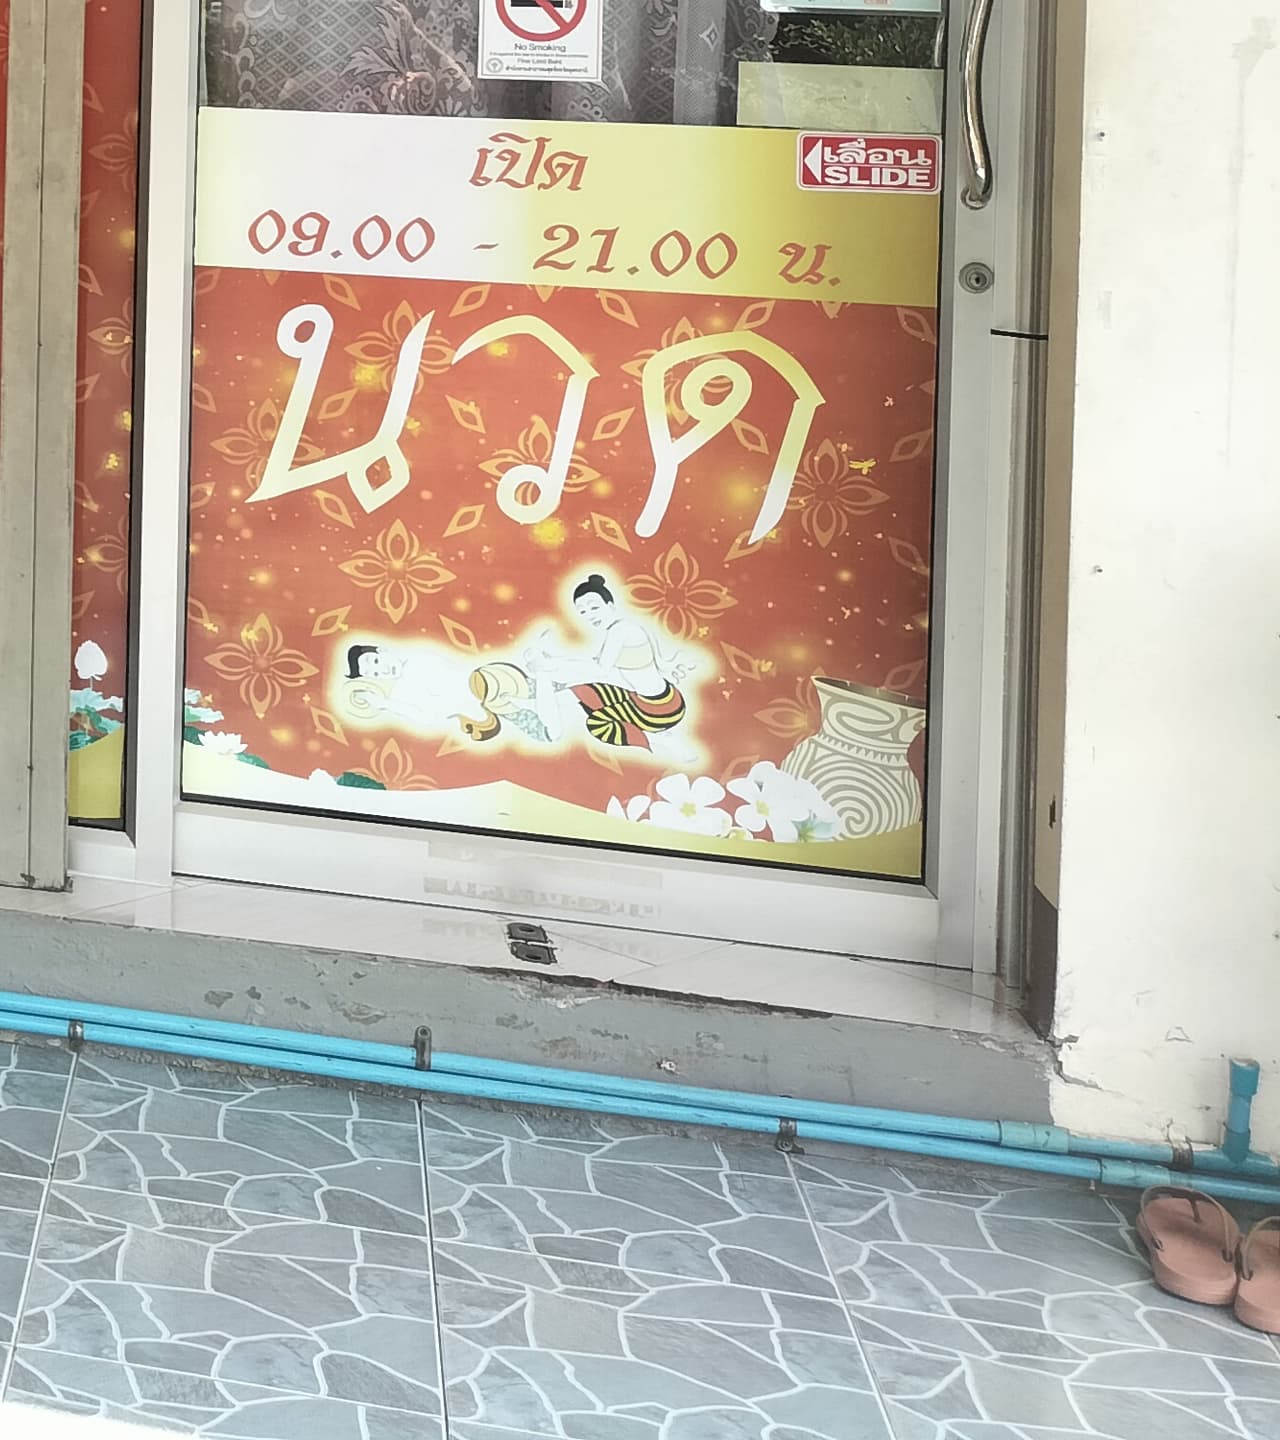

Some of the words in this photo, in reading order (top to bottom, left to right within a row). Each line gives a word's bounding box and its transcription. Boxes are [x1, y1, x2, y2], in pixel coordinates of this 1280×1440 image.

[468, 131, 589, 192] เปิด
[823, 138, 933, 165] เลื่อน
[824, 166, 931, 187] SLIDE
[246, 208, 437, 263] 09.00
[531, 223, 739, 280] 21.00
[778, 240, 843, 288] น.
[244, 302, 827, 546] นวด
